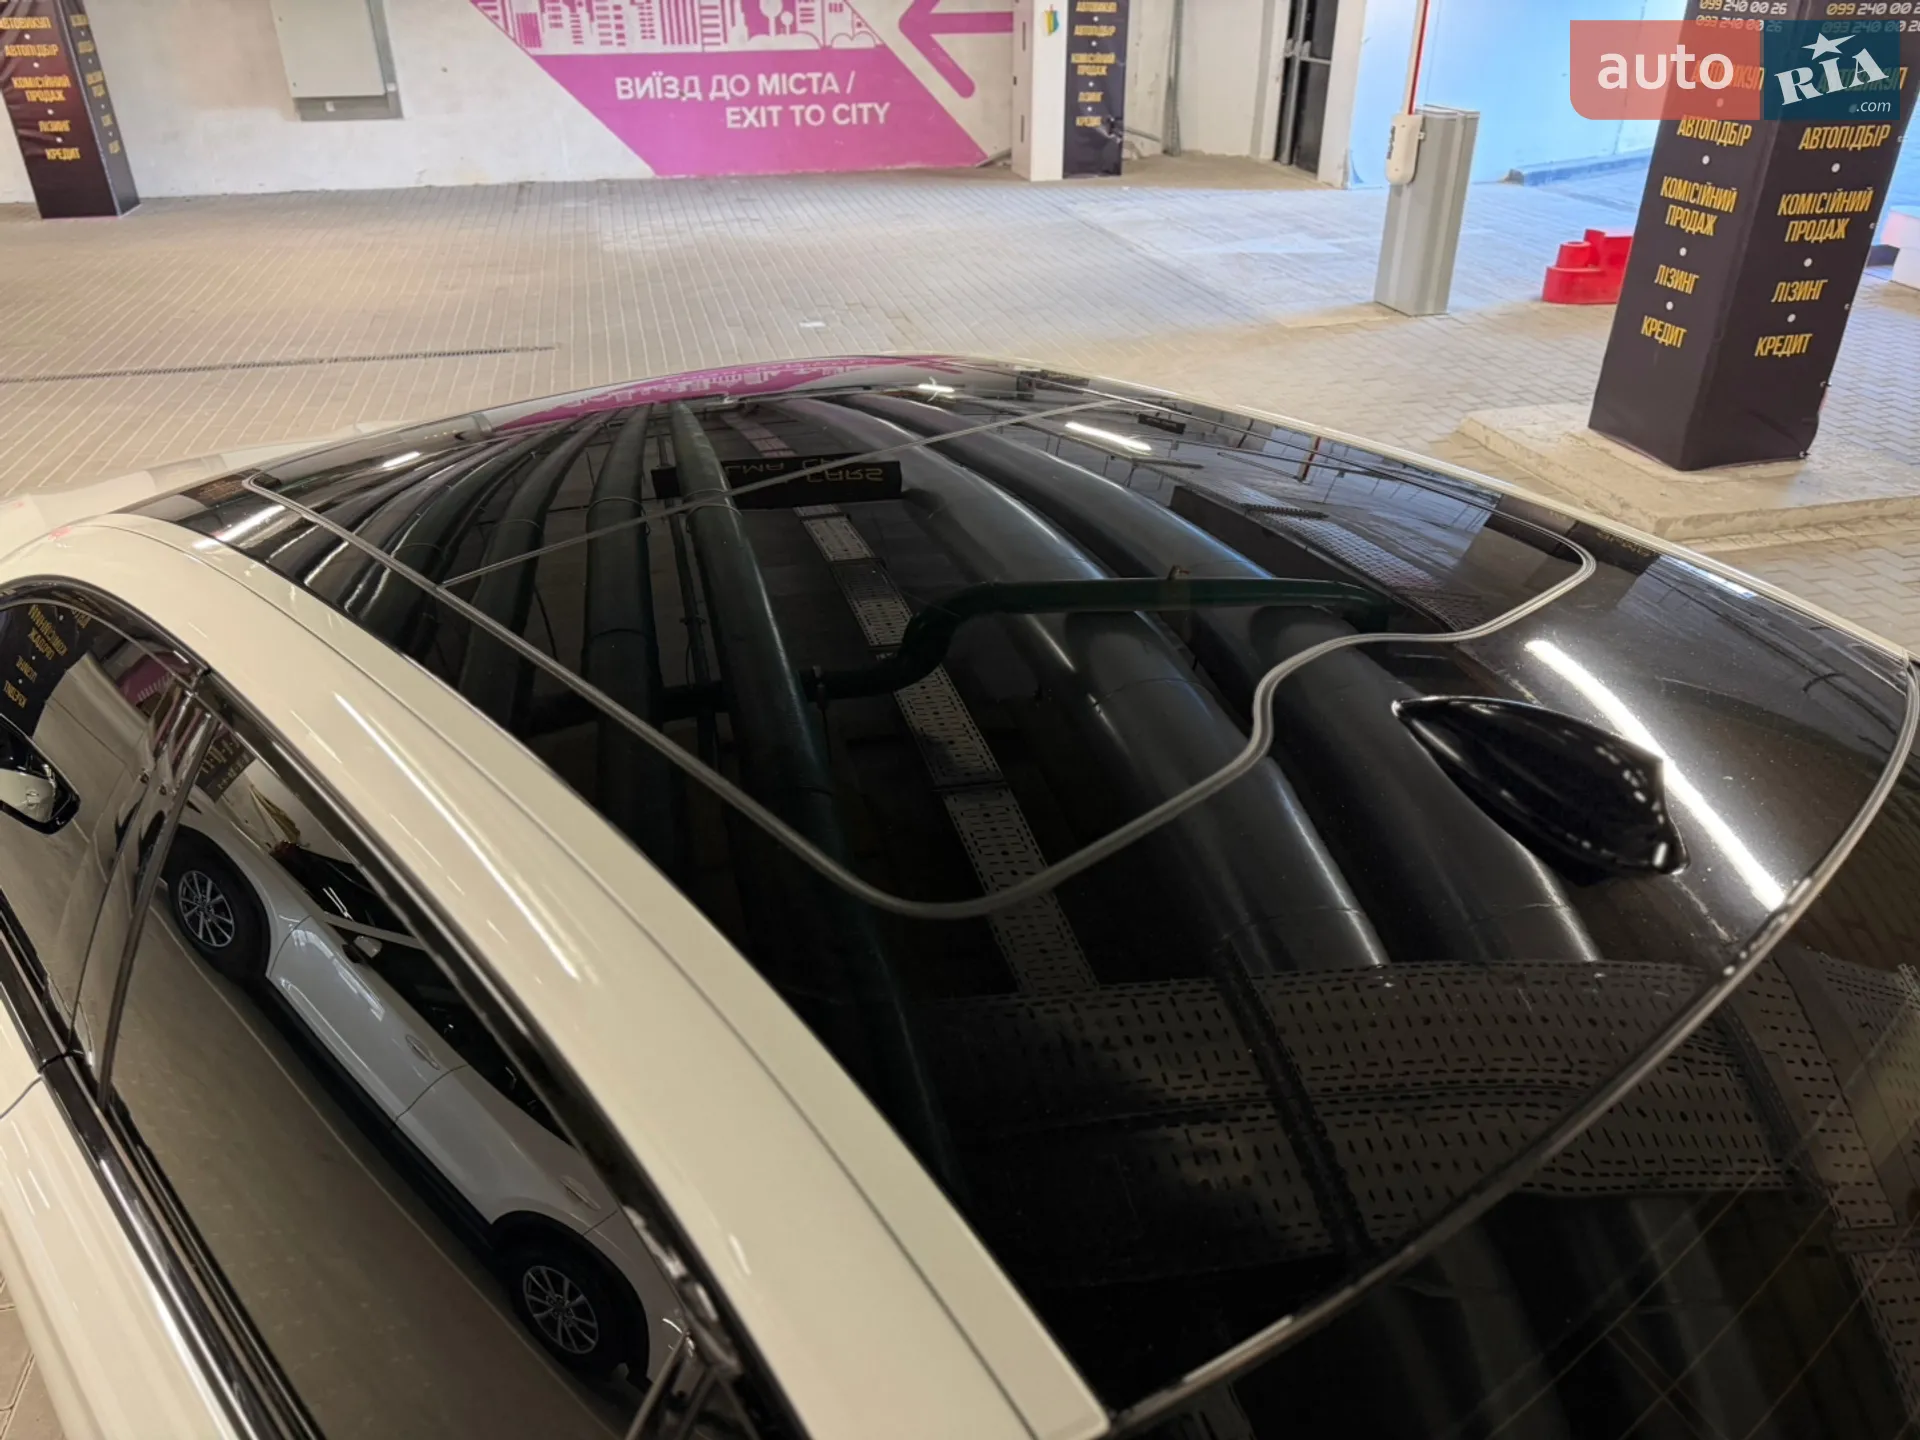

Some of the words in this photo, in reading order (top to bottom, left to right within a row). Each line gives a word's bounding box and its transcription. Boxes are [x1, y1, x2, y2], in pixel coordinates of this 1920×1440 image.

[1699, 0, 1722, 11] 099
[1723, 0, 1748, 12] 240
[1749, 1, 1769, 14] 00
[1770, 2, 1788, 15] 26
[1826, 3, 1856, 16] 099
[1857, 3, 1887, 16] 240
[1889, 2, 1912, 15] 00
[615, 71, 702, 101] ВИЇЗД
[709, 74, 751, 101] ДО
[757, 72, 840, 97] МІСТА
[726, 105, 782, 128] EXIT
[789, 104, 825, 127] TO
[832, 102, 890, 125] CITY
[1676, 114, 1752, 147] АВТОПІДБІР
[1798, 124, 1891, 151] АВТОПІДБІР
[1660, 175, 1738, 213] КОМІСІЙНИЙ
[1777, 186, 1874, 216] КОМІСІЙНИЙ
[1665, 204, 1718, 236] ПРОДАЖ
[1784, 218, 1850, 244] ПРОДАЖ
[1654, 264, 1700, 295] ЛІЗИНГ
[1771, 279, 1828, 303] ЛІЗИНГ
[1641, 315, 1687, 348] КРЕДИТ
[1754, 333, 1813, 358] КРЕДИТ
